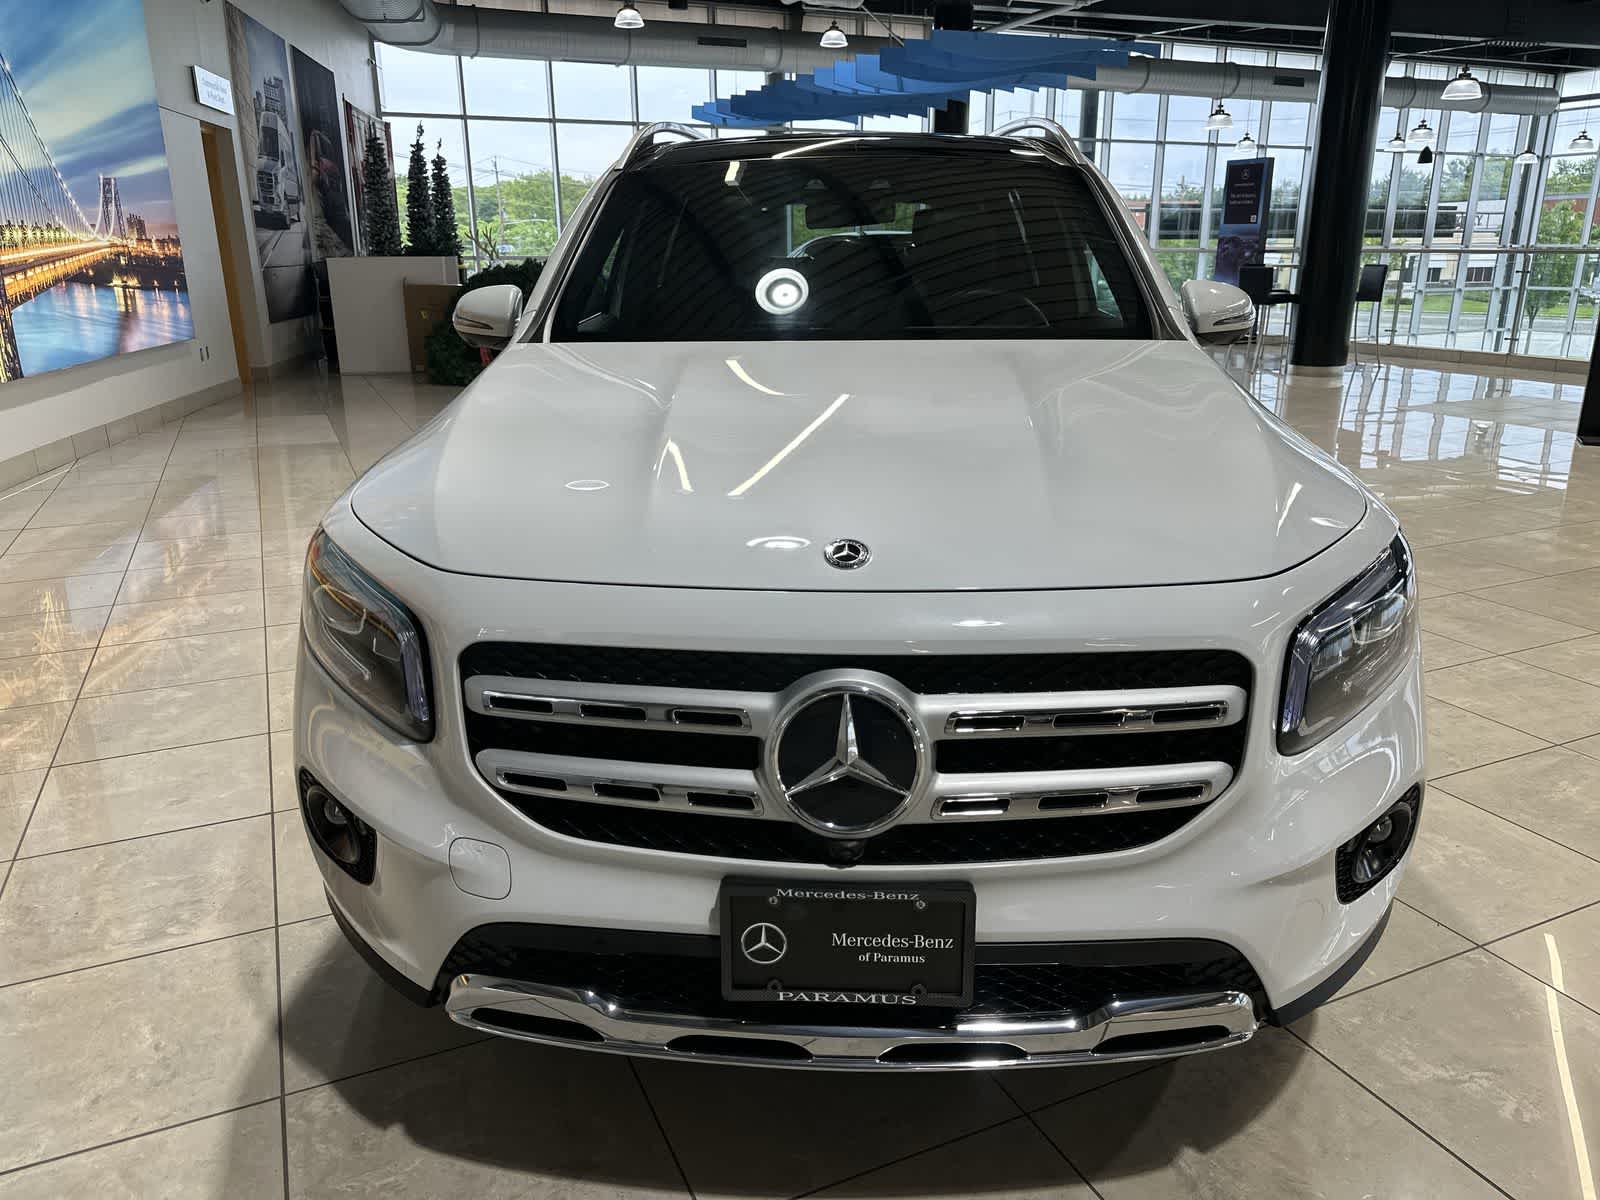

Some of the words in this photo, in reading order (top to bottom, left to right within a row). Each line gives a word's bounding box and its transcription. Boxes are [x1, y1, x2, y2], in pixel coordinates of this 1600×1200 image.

[776, 888, 919, 901] Mercedes-Benz
[831, 932, 954, 949] Mercedes-Benz
[858, 952, 870, 962] of
[873, 952, 926, 964] Paramus
[777, 991, 917, 1005] PARAMUS
